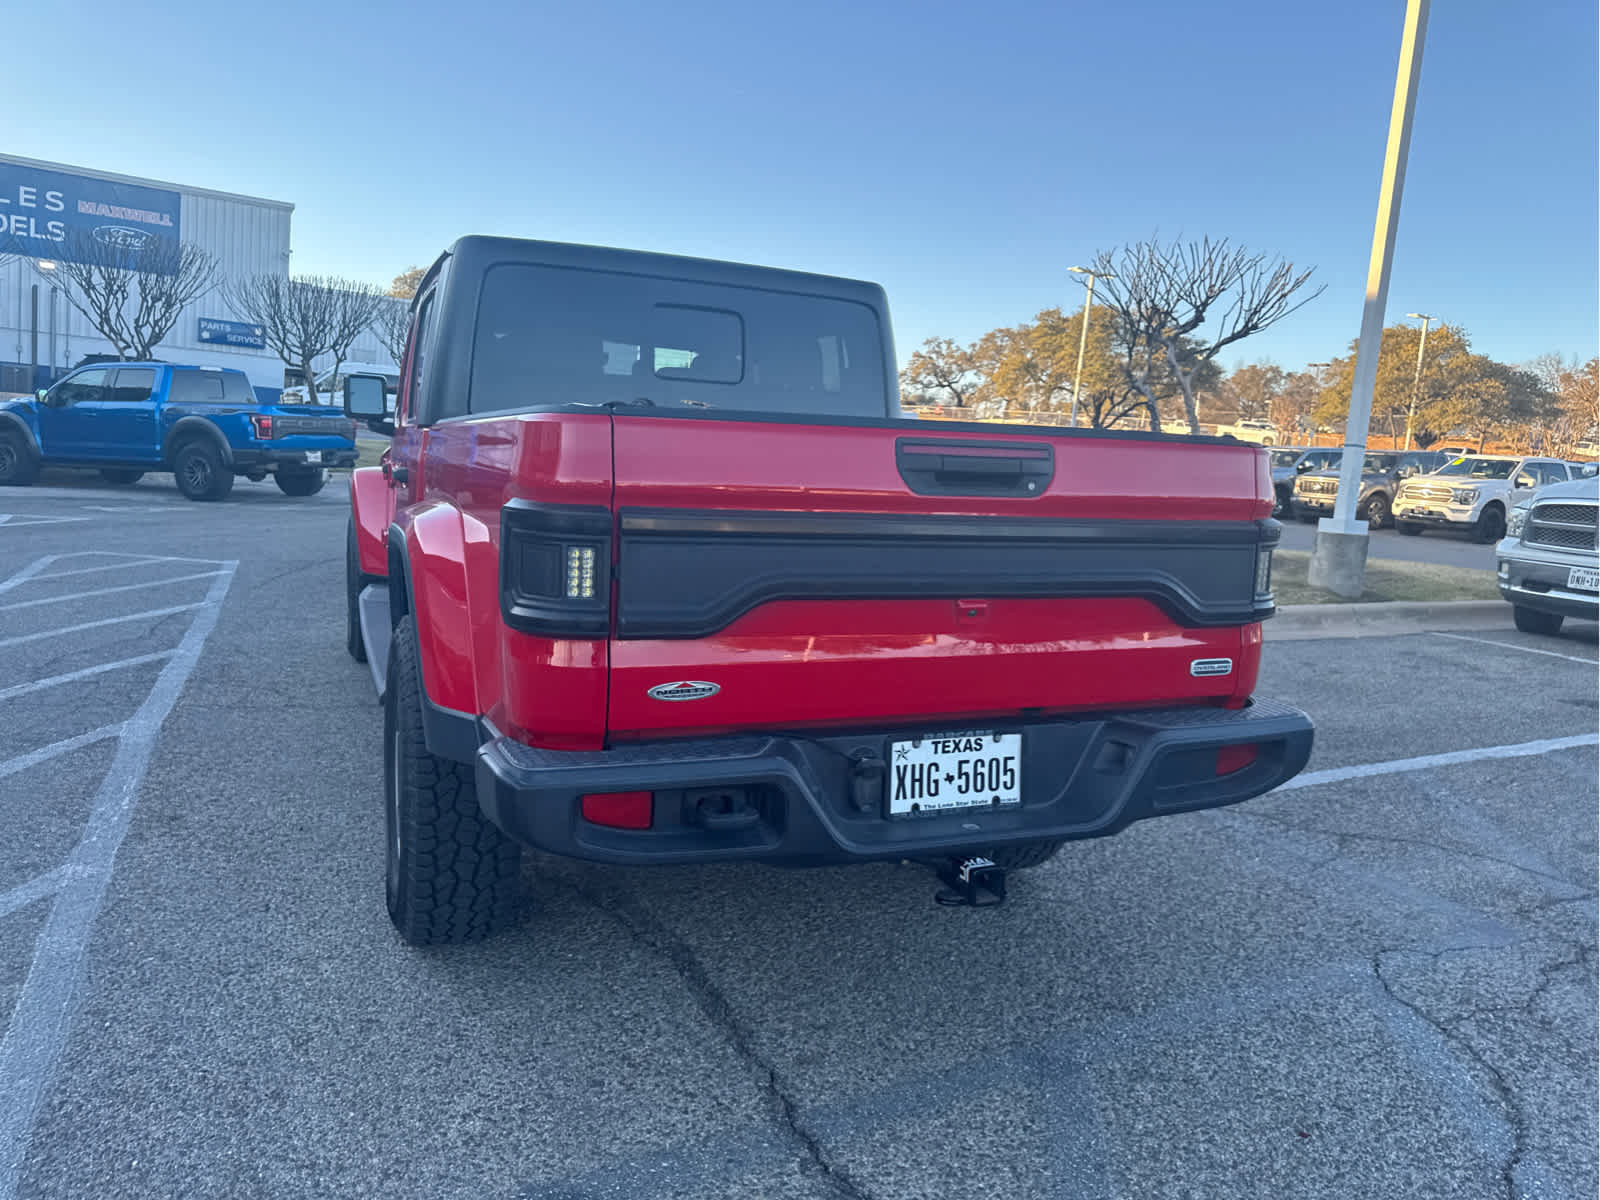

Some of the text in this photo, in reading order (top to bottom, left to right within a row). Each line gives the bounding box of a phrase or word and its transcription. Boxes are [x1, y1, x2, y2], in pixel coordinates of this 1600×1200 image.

[78, 200, 173, 227] MAXWELL
[200, 321, 232, 332] PARTS
[931, 738, 983, 755] TEXAS
[895, 756, 1015, 800] XHG 5605
